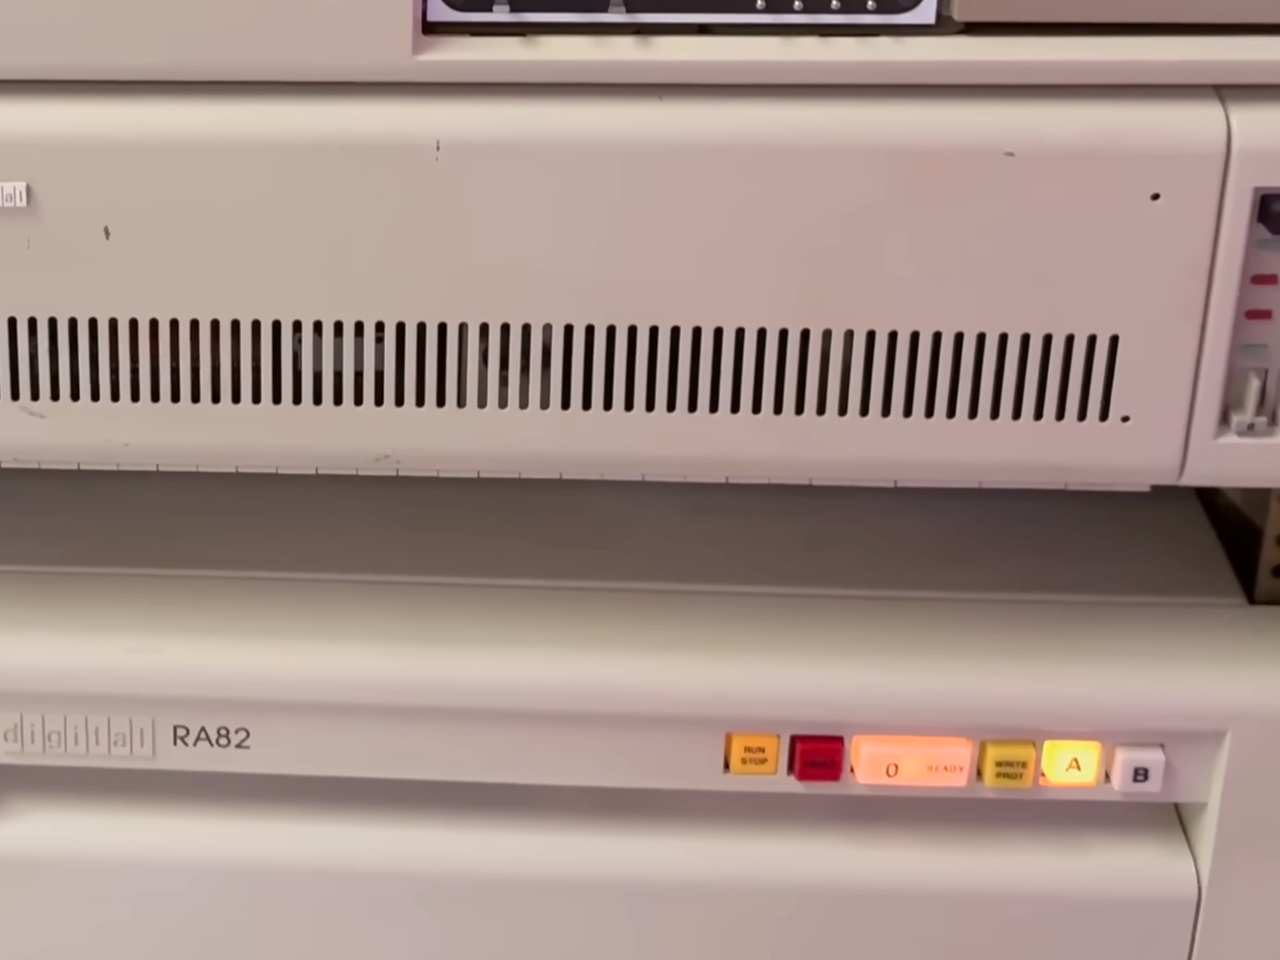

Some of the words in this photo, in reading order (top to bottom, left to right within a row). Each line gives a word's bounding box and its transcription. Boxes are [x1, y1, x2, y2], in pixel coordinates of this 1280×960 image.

[3, 719, 150, 751] digital
[172, 724, 251, 749] RA82
[744, 746, 766, 754] RUN
[740, 757, 769, 766] STOP
[995, 760, 1028, 770] WRITE
[1065, 757, 1082, 772] A
[927, 764, 965, 774] READY
[995, 771, 1024, 780] PROT
[1132, 766, 1149, 783] B
